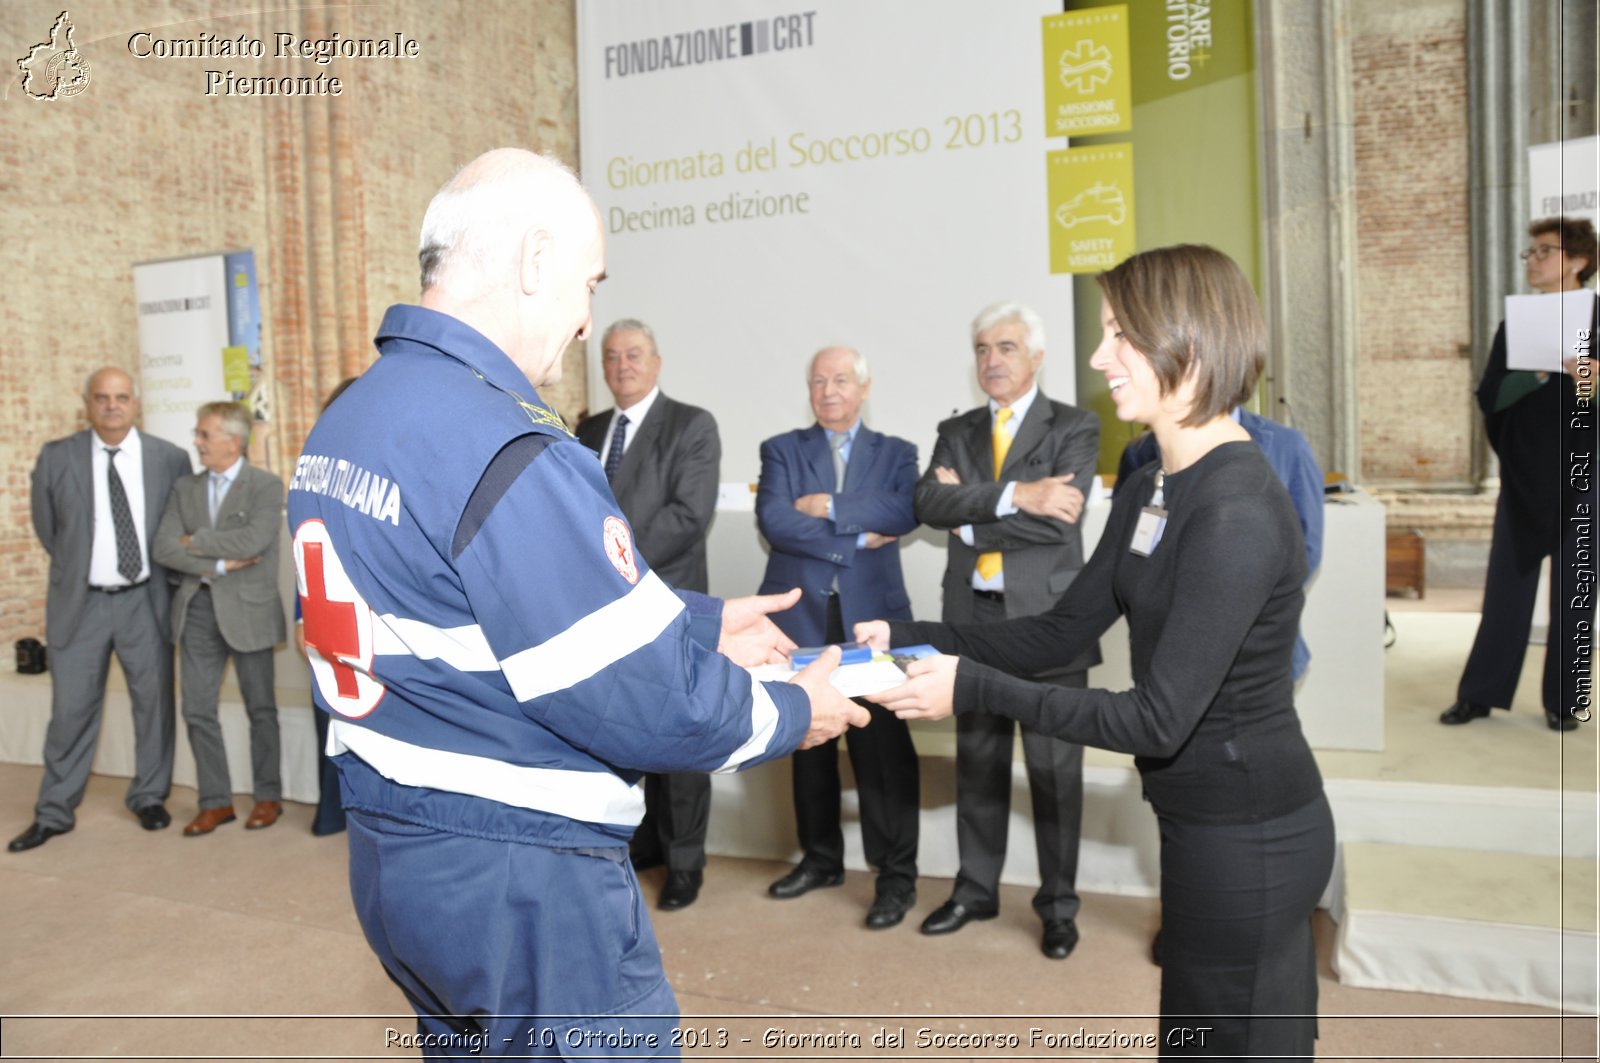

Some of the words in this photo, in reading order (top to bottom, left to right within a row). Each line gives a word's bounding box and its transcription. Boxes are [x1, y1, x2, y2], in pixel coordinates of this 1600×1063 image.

[605, 25, 737, 79] FONDAZIONE
[773, 11, 816, 51] CRT
[1058, 100, 1116, 115] MISSIONE
[1056, 114, 1120, 130] SOCCORSO
[607, 149, 724, 190] Giornata
[735, 137, 777, 173] del
[788, 127, 931, 168] Soccorso
[944, 109, 1023, 149] 2013
[609, 202, 695, 234] Decima
[705, 190, 810, 223] edizione
[1070, 239, 1113, 253] SAFETY
[1068, 252, 1115, 267] VEHICLE
